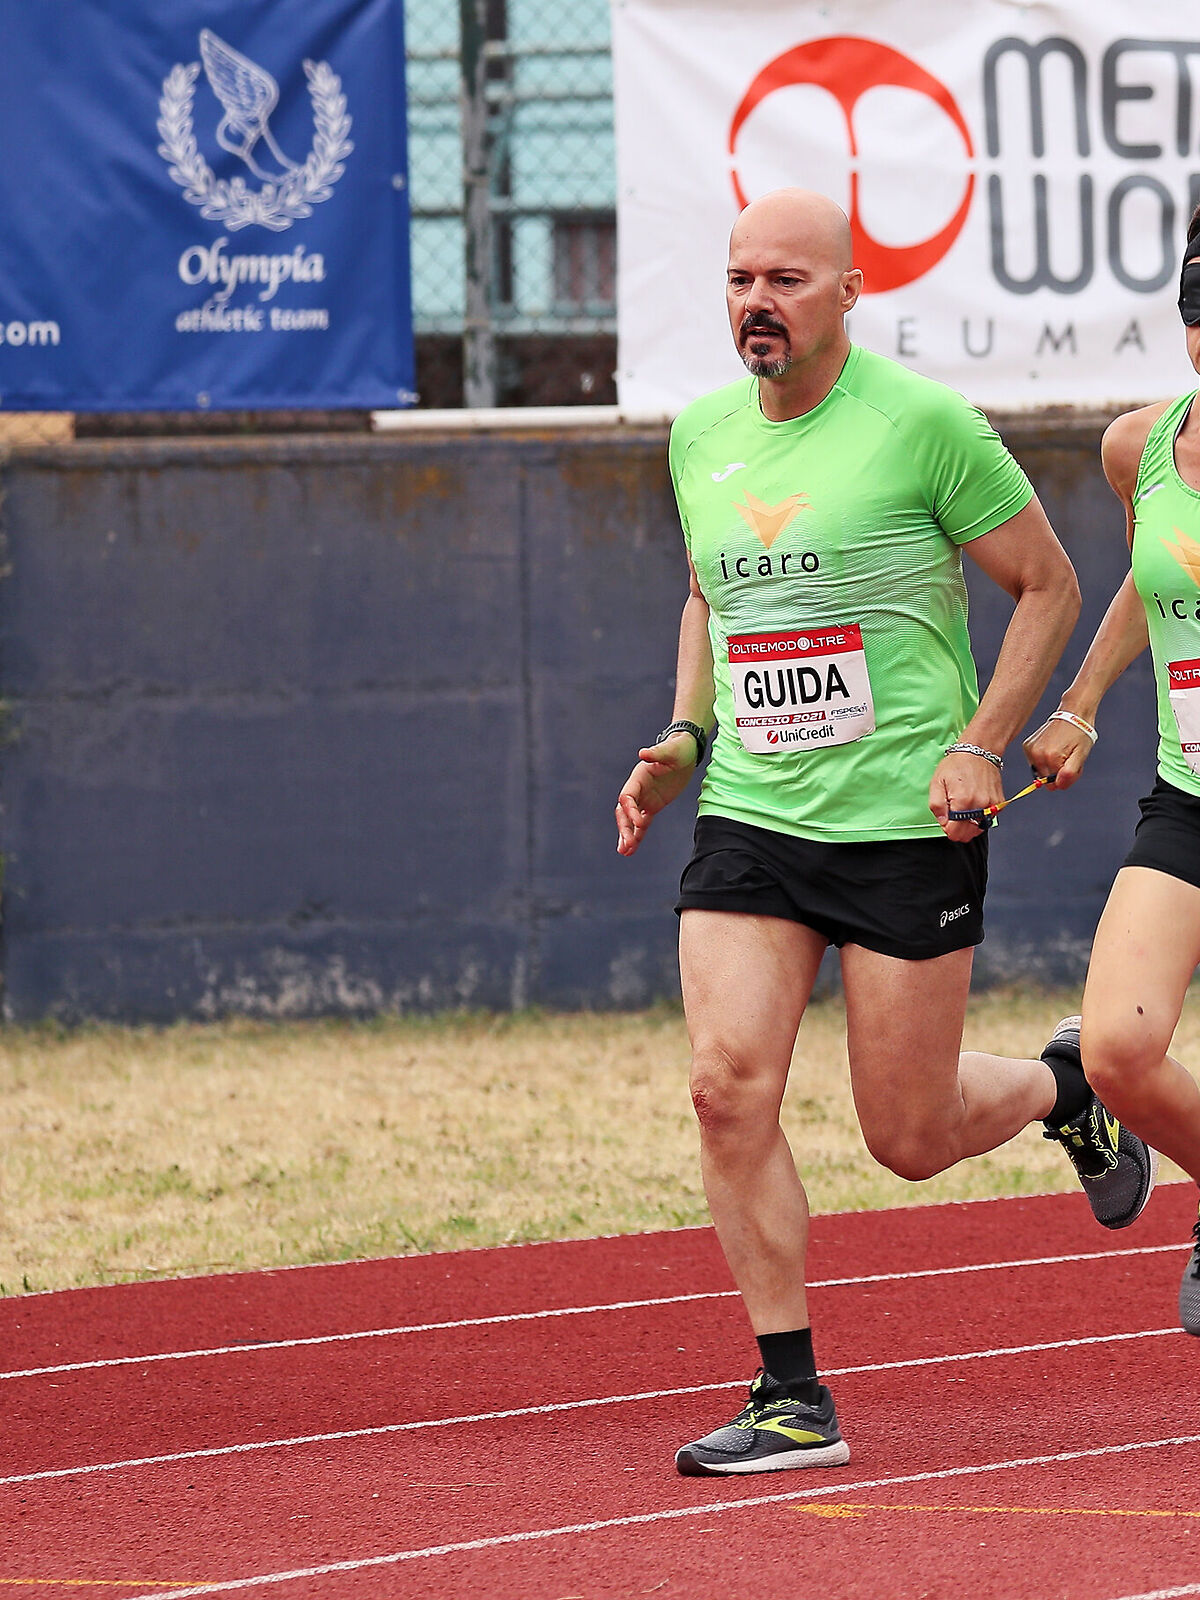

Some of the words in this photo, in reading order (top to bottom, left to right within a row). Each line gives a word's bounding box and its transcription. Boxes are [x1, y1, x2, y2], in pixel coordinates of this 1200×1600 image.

[178, 236, 326, 302] Olympia
[175, 299, 264, 332] athletic
[270, 307, 330, 332] team
[0, 320, 60, 346] om
[720, 551, 820, 580] icaro
[744, 663, 850, 709] GUIDA
[739, 715, 790, 727] CONCESIO
[792, 711, 824, 723] 2021
[780, 725, 835, 743] UniCredit
[948, 903, 970, 921] asics
